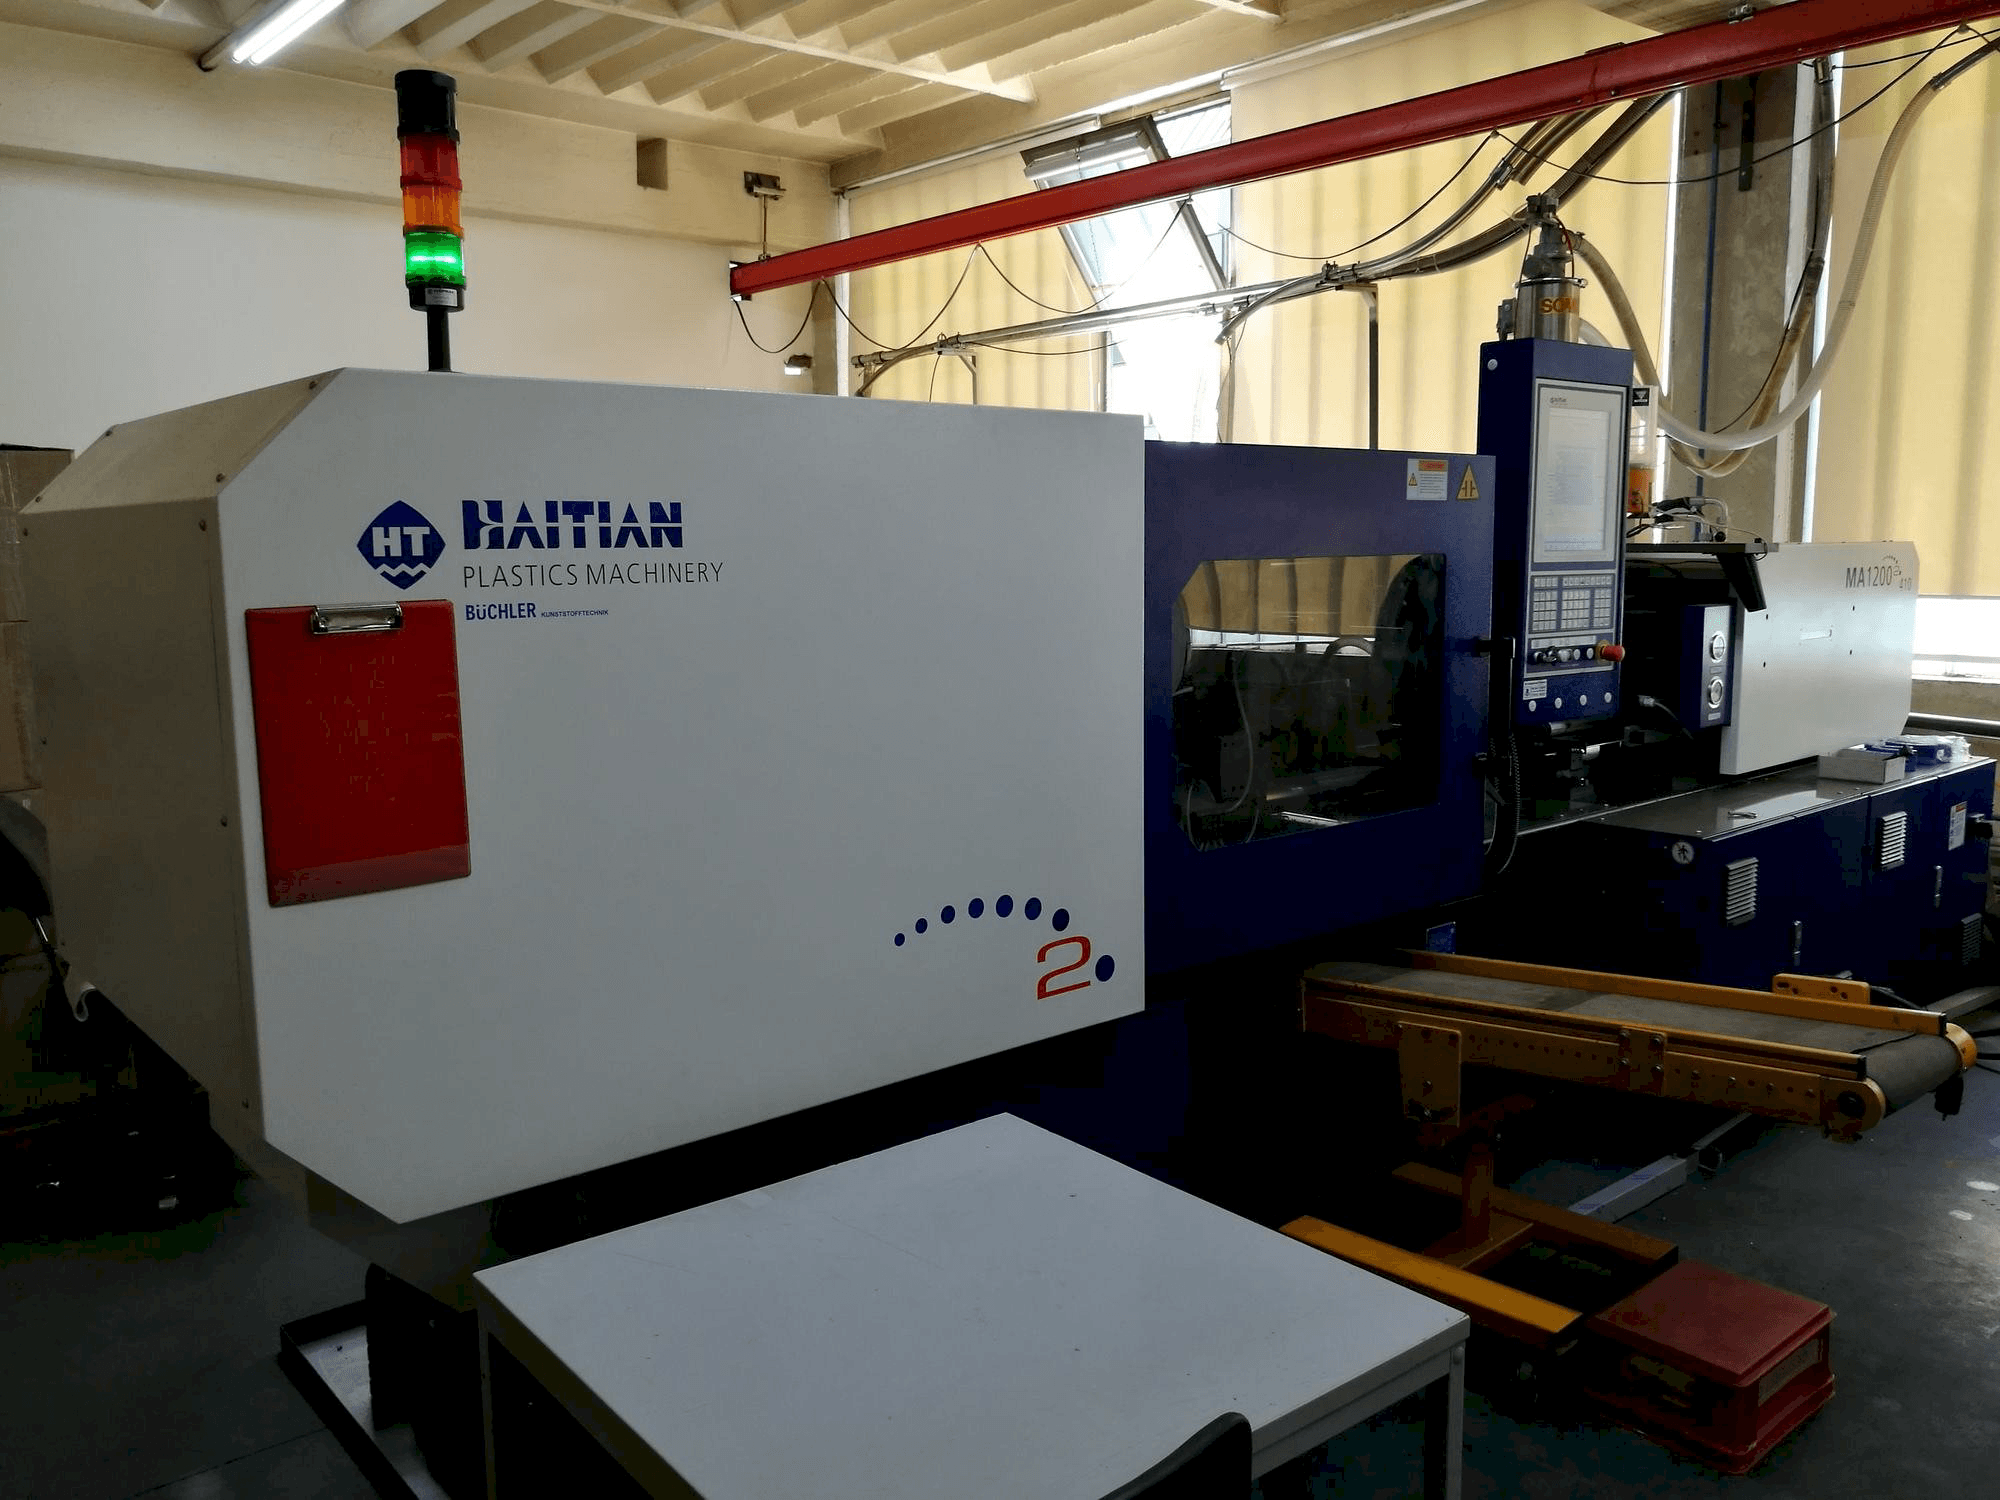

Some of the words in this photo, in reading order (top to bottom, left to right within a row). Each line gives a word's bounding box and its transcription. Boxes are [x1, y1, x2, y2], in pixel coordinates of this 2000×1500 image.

[462, 500, 683, 550] HAITIAN
[372, 526, 430, 558] HT
[463, 564, 578, 588] PLASTICS
[586, 562, 724, 586] MACHINERY
[1845, 566, 1893, 588] MA1200
[541, 609, 609, 618] KUNSTSTOFFTECHNIK
[1037, 936, 1091, 1000] 2
